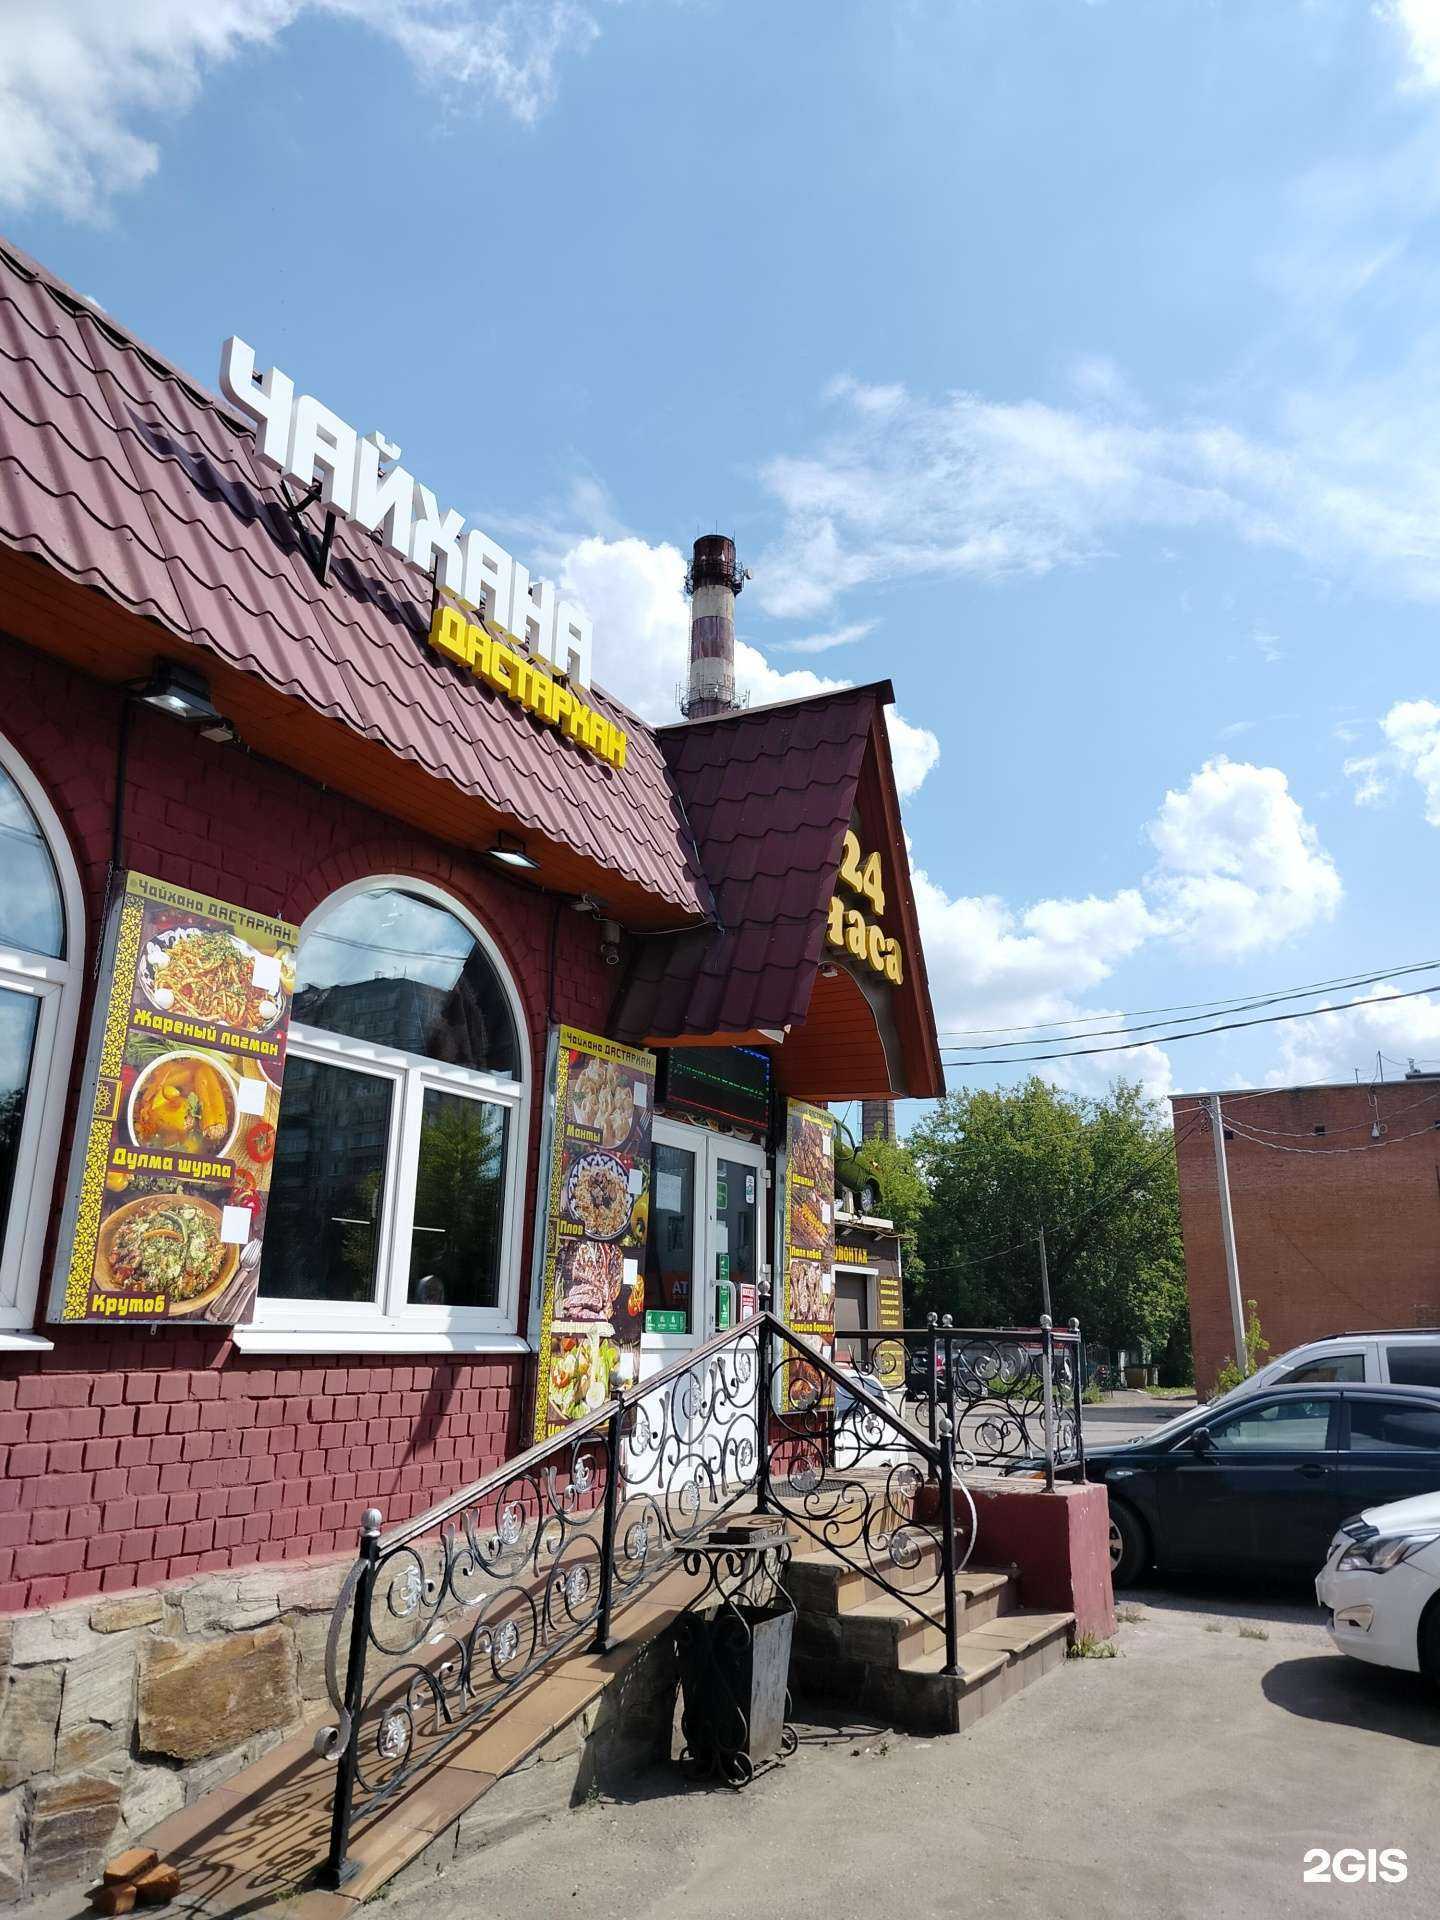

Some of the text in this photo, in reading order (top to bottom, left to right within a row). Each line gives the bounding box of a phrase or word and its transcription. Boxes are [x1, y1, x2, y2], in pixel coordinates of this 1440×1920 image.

[220, 335, 592, 693] ЧАЙХАНА
[429, 606, 627, 769] ДАСТАРХАН
[838, 829, 885, 915] 24
[138, 879, 291, 940] Чайхана ДАСТАРХАН
[133, 1008, 278, 1056] Жареный лагман
[605, 1045, 651, 1069] ДАСТАРХАН
[566, 1124, 600, 1143] Манты
[112, 1148, 232, 1178] Дулма шурпа
[560, 1220, 583, 1235] Плов
[91, 1294, 166, 1317] Крутоб
